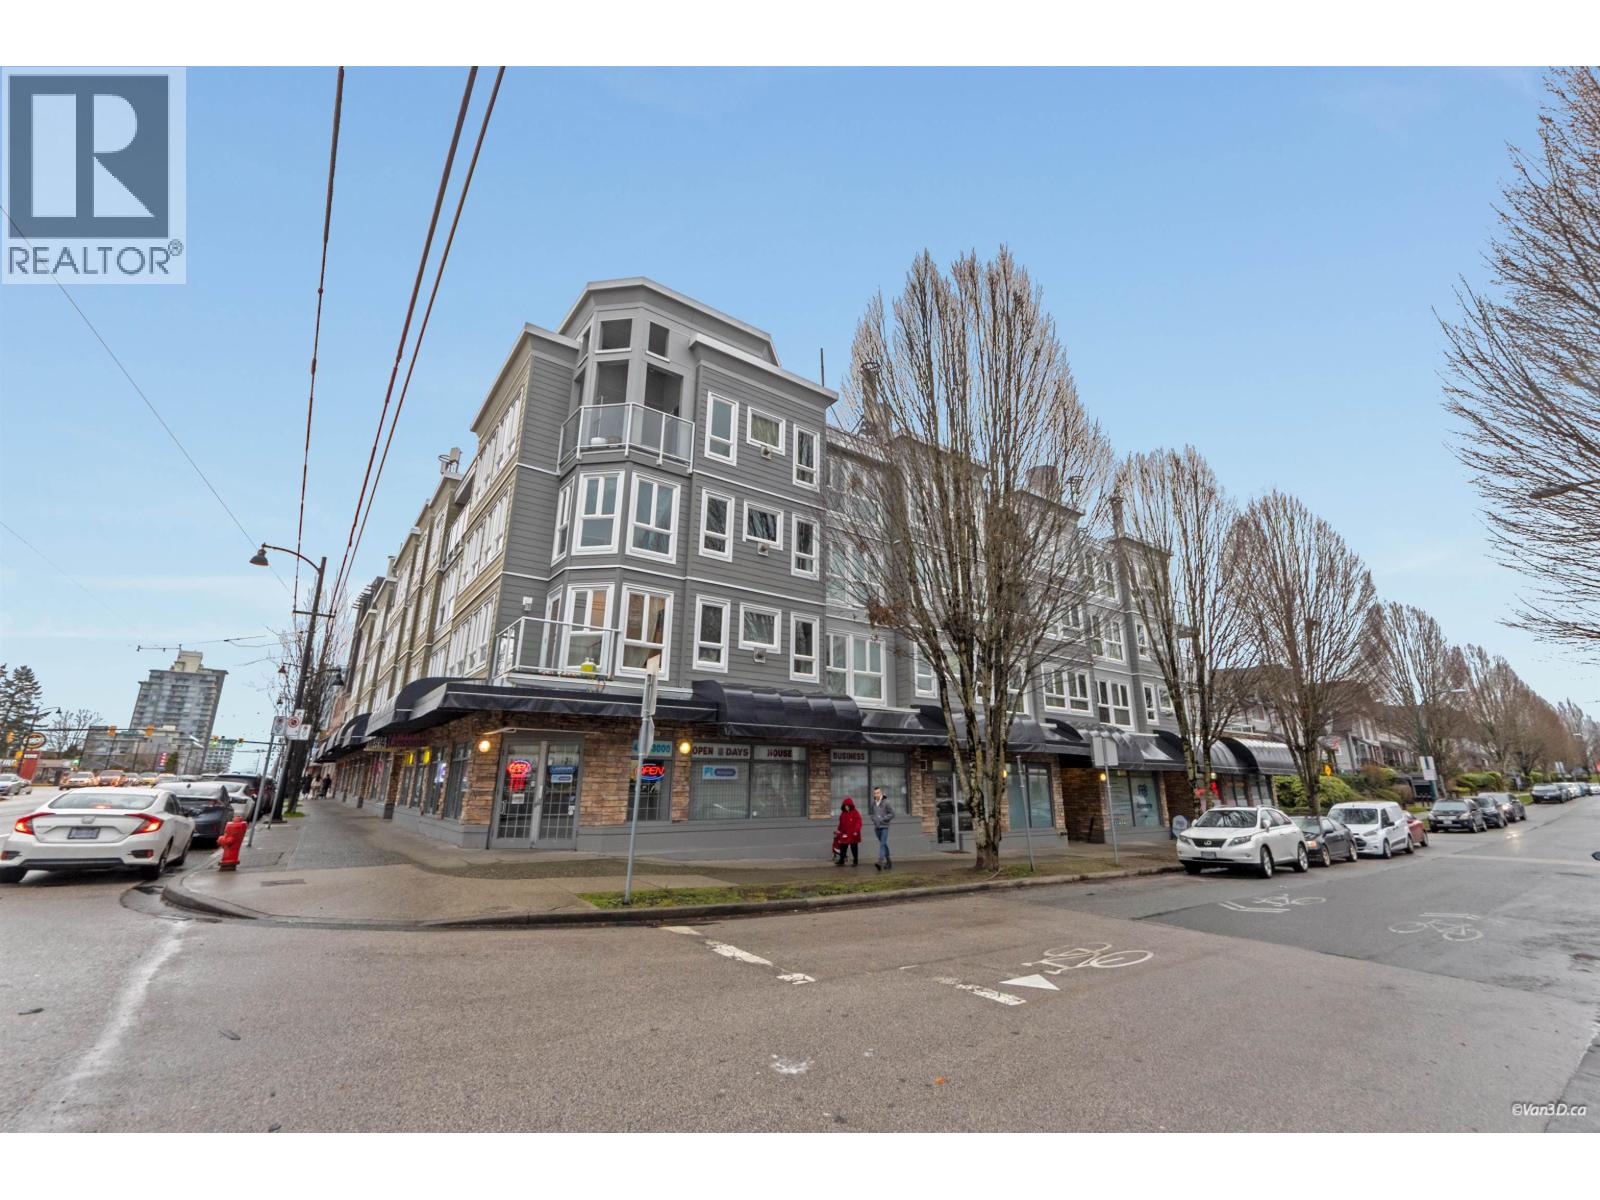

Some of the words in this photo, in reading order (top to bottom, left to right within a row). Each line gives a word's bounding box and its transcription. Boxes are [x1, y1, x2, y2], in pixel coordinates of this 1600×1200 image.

[692, 746, 714, 755] OPEN
[725, 747, 749, 756] DAYS
[767, 748, 793, 758] HOUSE
[832, 751, 866, 761] BUSINESS
